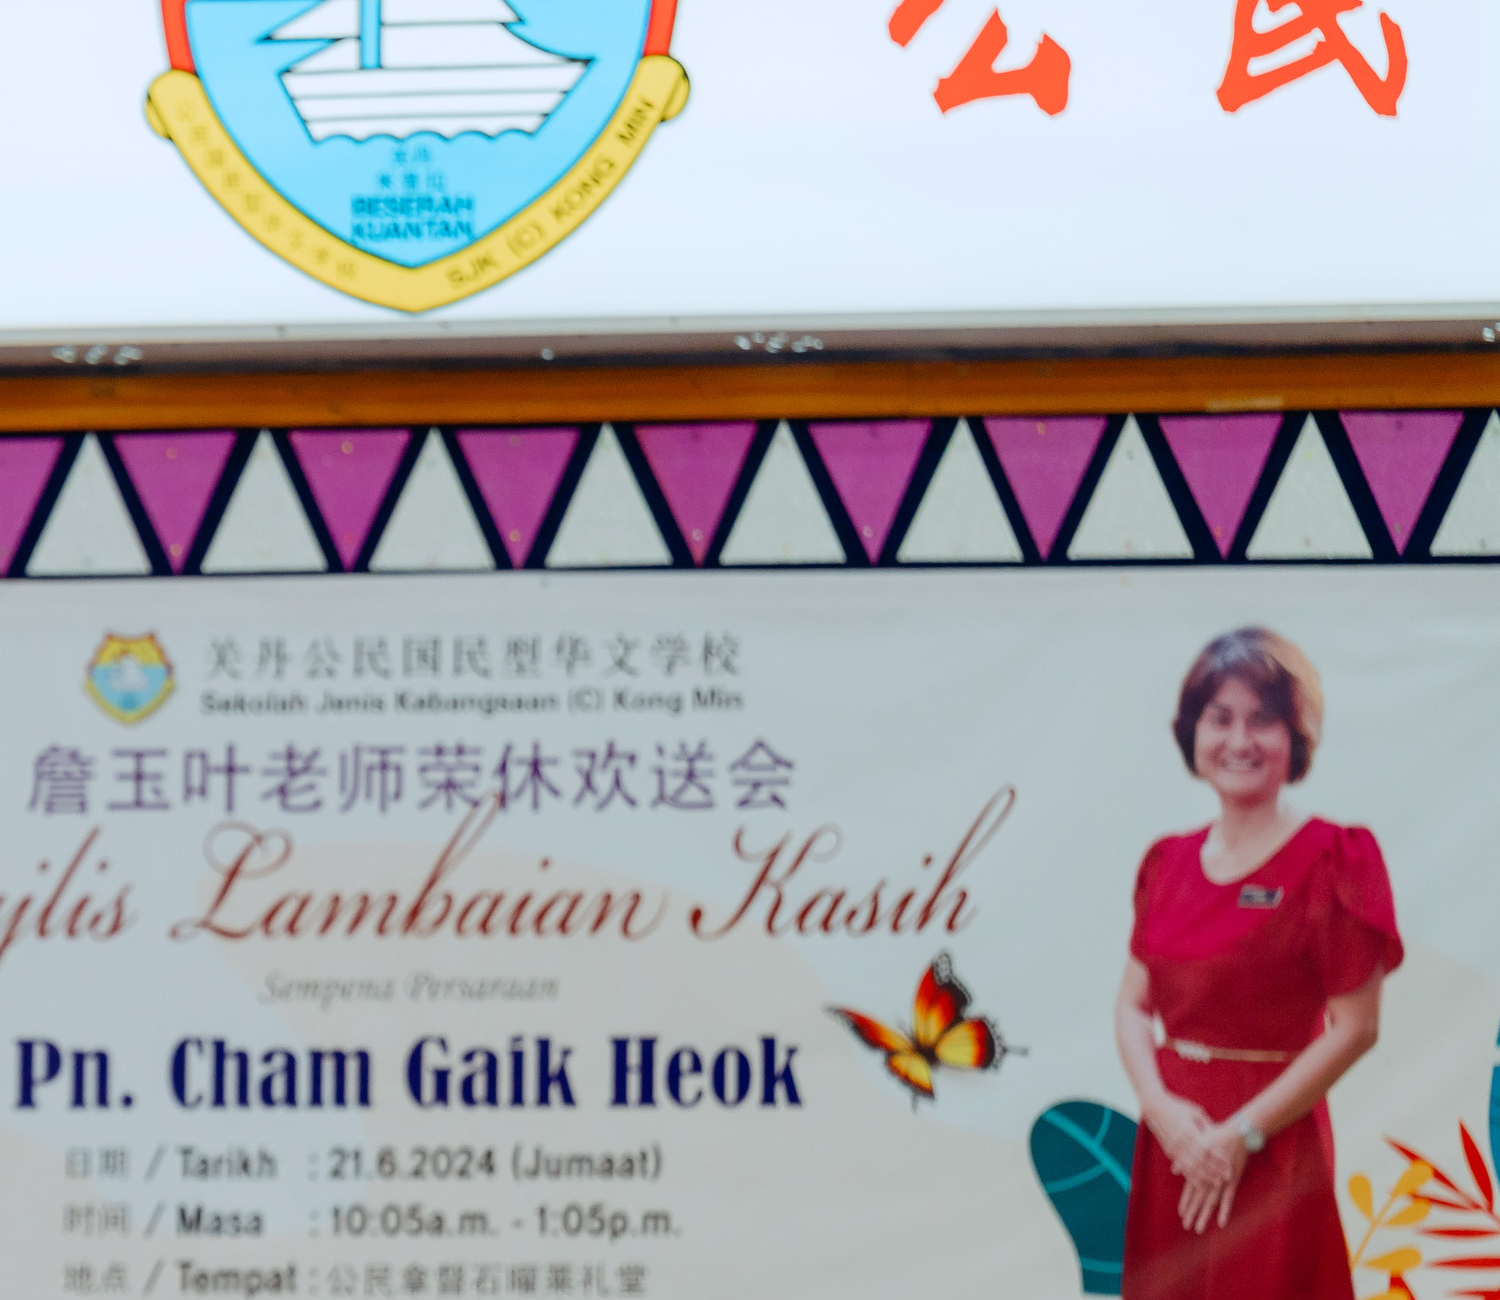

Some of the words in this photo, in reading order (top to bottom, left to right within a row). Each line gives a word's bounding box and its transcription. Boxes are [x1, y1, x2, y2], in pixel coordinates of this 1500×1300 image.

[550, 157, 616, 221] KONG
[351, 219, 476, 241] KUANTAN
[320, 689, 384, 715] Jenis
[569, 689, 601, 714] (C)
[613, 688, 684, 718] Kong
[694, 688, 744, 712] Min
[30, 738, 797, 815] 詹玉叶老师荣休欢送会
[168, 786, 670, 941] Lambaian
[691, 784, 1016, 941] Kasih
[14, 1037, 134, 1111] Pn.
[168, 1036, 372, 1110] Cham
[404, 1036, 576, 1110] Gaik
[609, 1035, 804, 1110] Heok
[177, 1147, 278, 1181] Tarikh
[327, 1148, 496, 1181] 21.6.2024
[511, 1145, 664, 1183] (Jumaat)
[177, 1205, 264, 1237] Masa
[177, 1262, 297, 1300] Tempat
